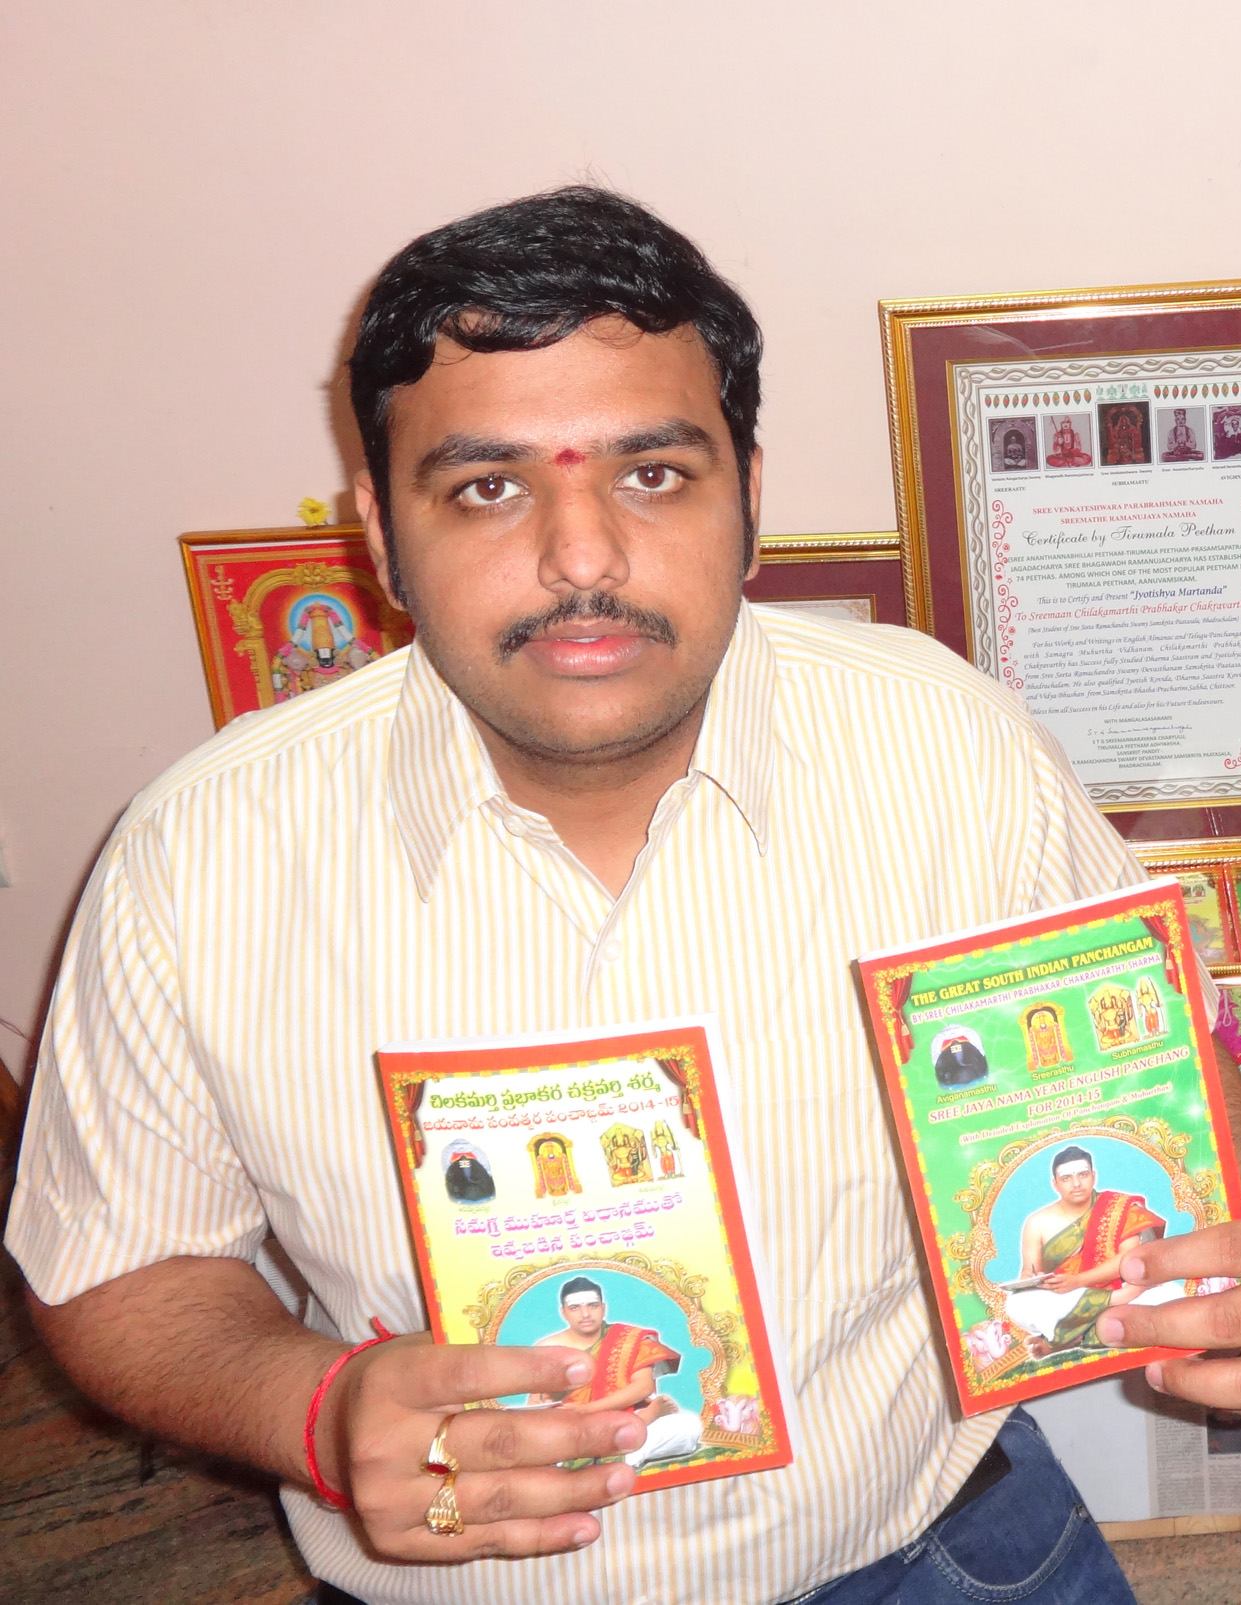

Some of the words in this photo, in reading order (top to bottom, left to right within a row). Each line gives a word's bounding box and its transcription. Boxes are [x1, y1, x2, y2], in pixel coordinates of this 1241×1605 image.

[1032, 507, 1052, 515] SREE
[1053, 504, 1122, 513] VENKATESHWARA
[1123, 500, 1187, 510] PARABRAHMANE
[1189, 498, 1223, 506] NAMAHA
[1061, 517, 1107, 525] SREEMATHE
[1109, 513, 1161, 523] RAMANUJAYA
[1162, 511, 1197, 519] NAMAHA
[1022, 530, 1088, 549] Certificate
[1091, 530, 1106, 547] by
[1110, 525, 1175, 541] Tirumala
[1179, 522, 1236, 537] Peetham
[1010, 564, 1063, 572] JAGADACHARYA
[1127, 556, 1192, 565] RAMANUJACHARYA
[1206, 563, 1239, 571] PEETHAM
[1102, 579, 1137, 587] PEETHAM,
[1037, 596, 1051, 604] This
[1067, 594, 1090, 605] Certify
[1091, 593, 1103, 601] and
[1104, 592, 1128, 601] Present
[1178, 585, 1227, 597] Martanda"
[1015, 612, 1027, 621] To
[1028, 611, 1072, 621] Sreemaan
[1074, 605, 1138, 618] Chilakamarthi
[1140, 601, 1188, 613] Prabhakar
[911, 992, 937, 1007] THE
[939, 980, 982, 1000] GREAT
[983, 971, 1025, 990] SOUTH
[1027, 961, 1069, 980] INDIAN
[1071, 937, 1154, 968] PANCHANGAM
[911, 1014, 923, 1024] BY
[925, 1008, 943, 1020] SREE
[946, 992, 1012, 1016] CHILAKAMARTHI
[1014, 981, 1062, 998] PRABHAKAR
[1063, 964, 1126, 986] CHAKRAVARTHY
[1128, 954, 1162, 970] SHARMA
[1112, 1040, 1164, 1061] Subhamasthu
[1032, 1065, 1075, 1082] Sreerasthu
[429, 1090, 499, 1112] చిలకమర్తి
[501, 1083, 563, 1110] ప్రభాకర
[567, 1078, 624, 1101] చక్రవర్తి
[627, 1071, 661, 1093] శర్మ
[929, 1106, 962, 1124] SREE
[963, 1099, 995, 1117] JAYA
[997, 1090, 1033, 1109] NAMA
[1034, 1082, 1067, 1099] YEAR
[1068, 1067, 1121, 1089] ENGLISH
[1123, 1047, 1189, 1075] PANCHANG
[937, 1083, 998, 1105] Aviganamasthu
[1028, 1101, 1053, 1117] FOR
[1056, 1088, 1101, 1111] 2014-15
[423, 1117, 484, 1131] జయనామ
[960, 1131, 981, 1144] (With
[981, 1122, 1014, 1141] Detailed
[1015, 1112, 1061, 1132] Explanation
[1062, 1109, 1072, 1120] Of
[1073, 1098, 1120, 1118] Panchangam
[1121, 1095, 1128, 1105] &
[454, 1216, 501, 1238] సమగ్ర
